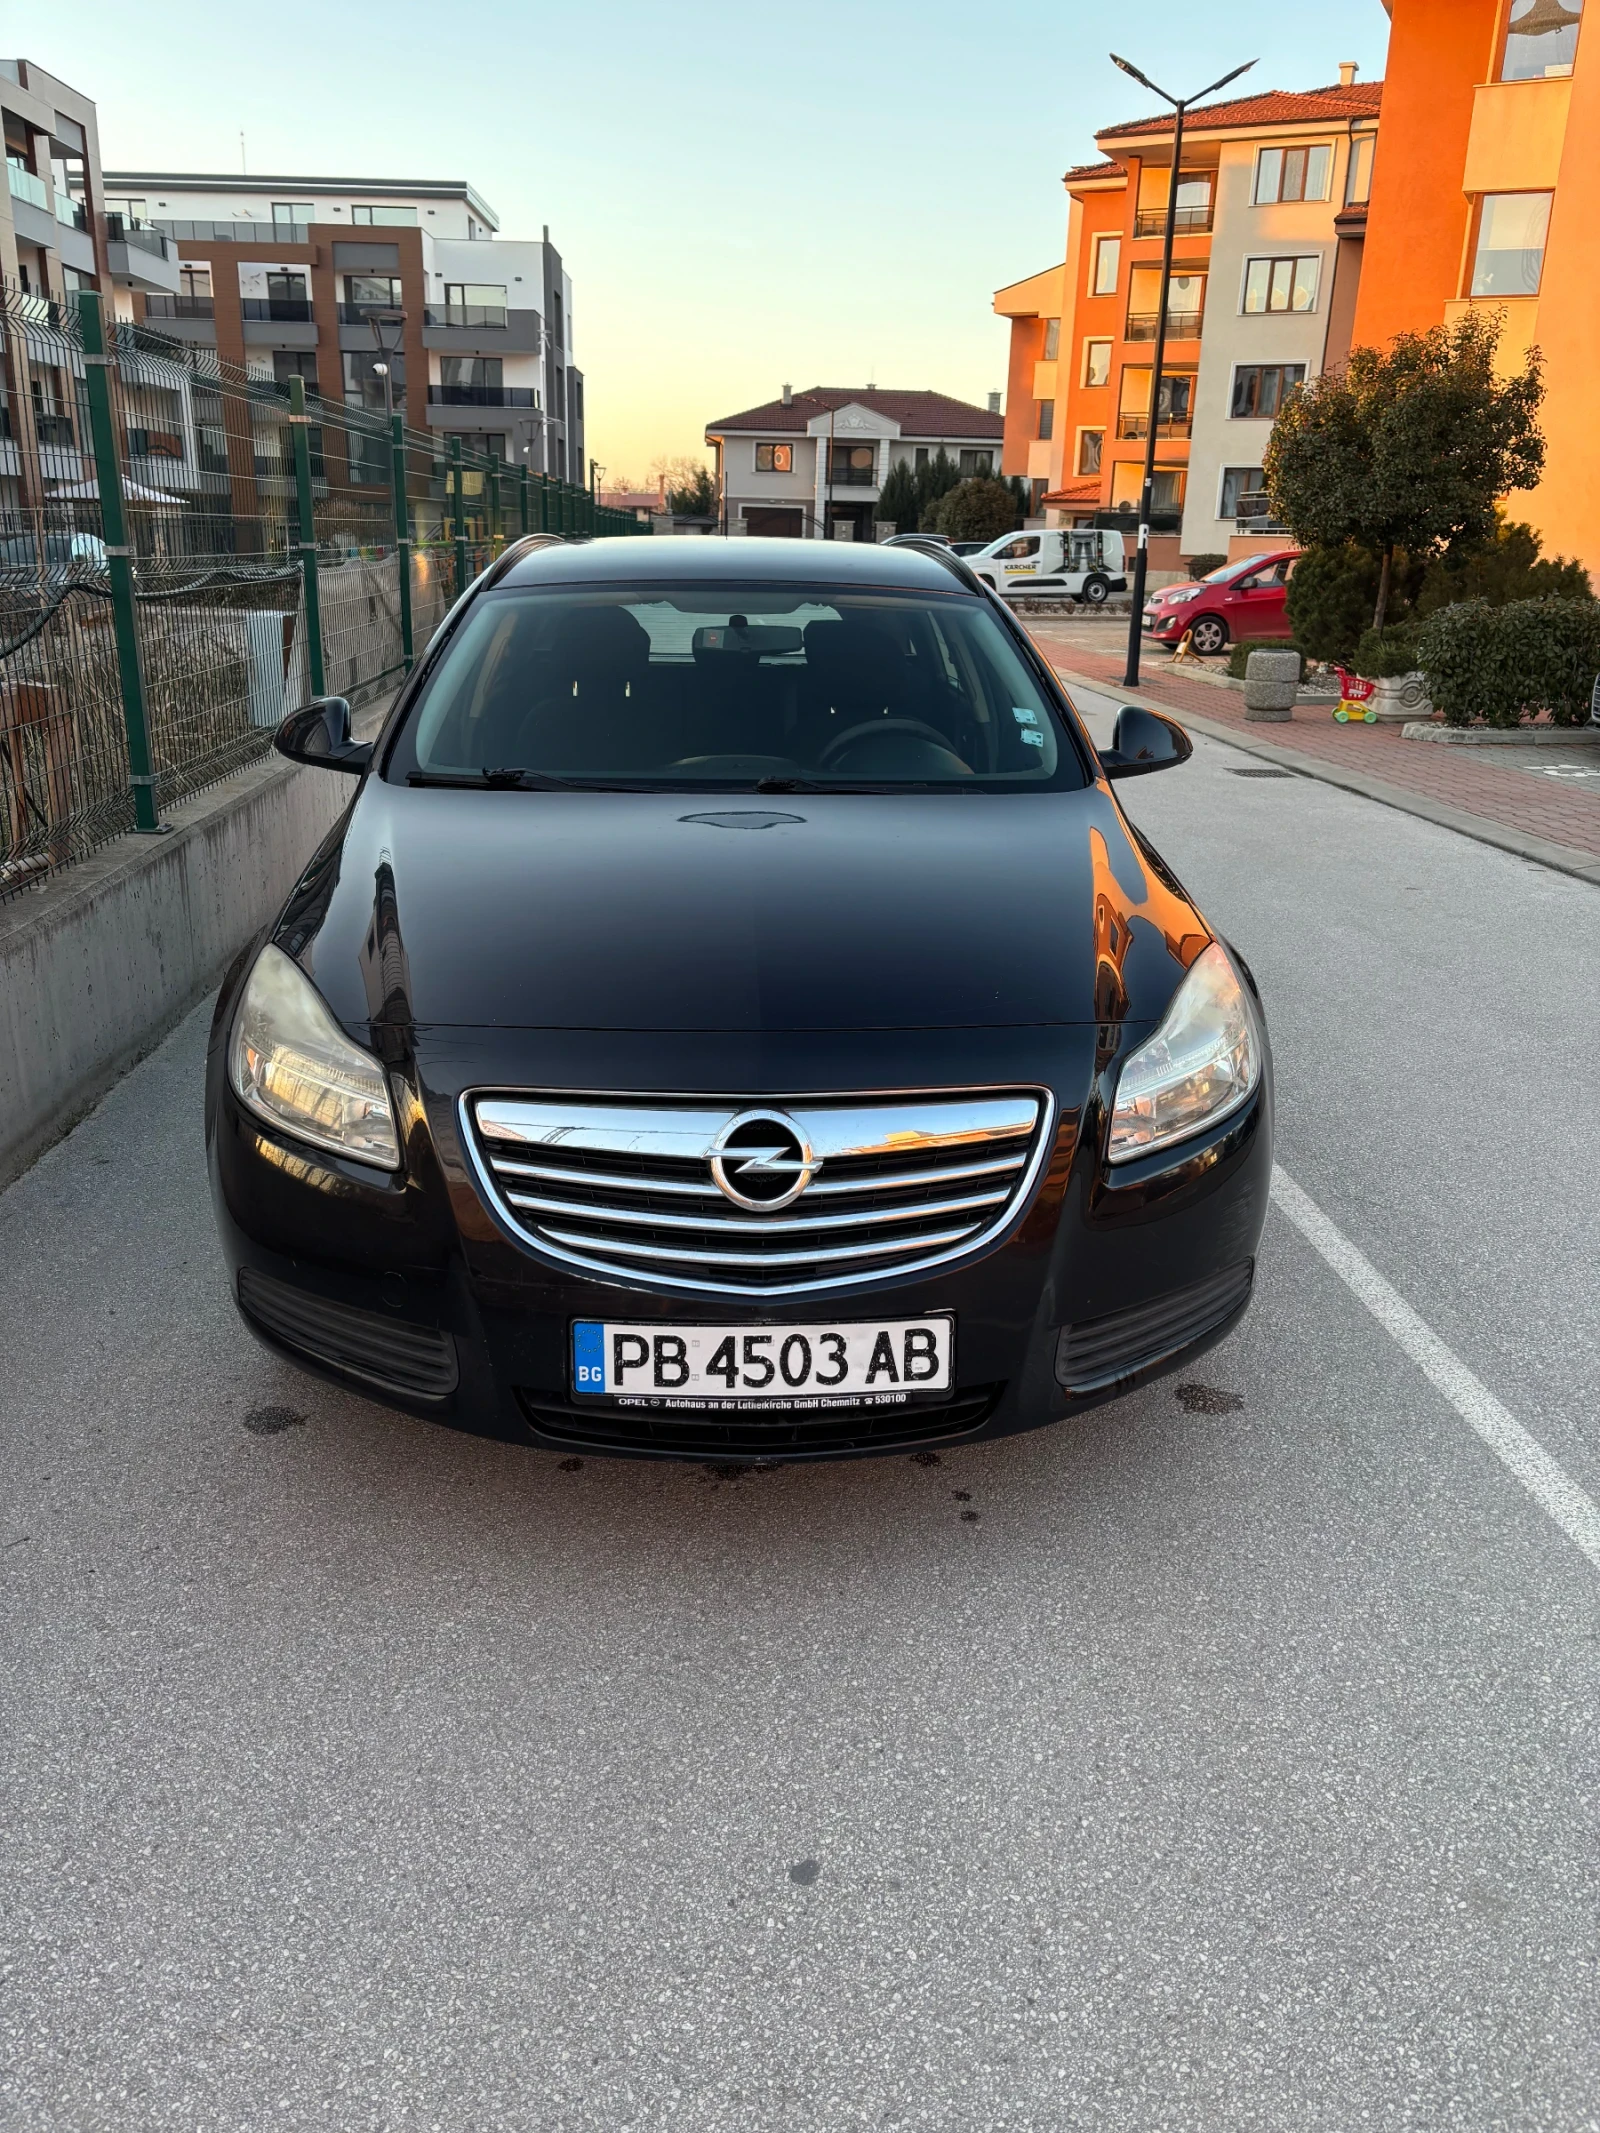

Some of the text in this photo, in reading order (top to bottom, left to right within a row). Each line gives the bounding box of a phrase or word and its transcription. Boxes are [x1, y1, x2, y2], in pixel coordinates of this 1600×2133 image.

[731, 1112, 793, 1126] OPEL
[613, 1328, 940, 1388] PB 4503 AB
[579, 1366, 602, 1382] BG
[618, 1398, 649, 1406] OPEL
[665, 1399, 706, 1408] Autohaus
[708, 1401, 718, 1409] an
[721, 1400, 735, 1409] der
[794, 1400, 818, 1409] GmbH
[820, 1398, 860, 1408] Chemnitz
[875, 1394, 906, 1404] 530100
